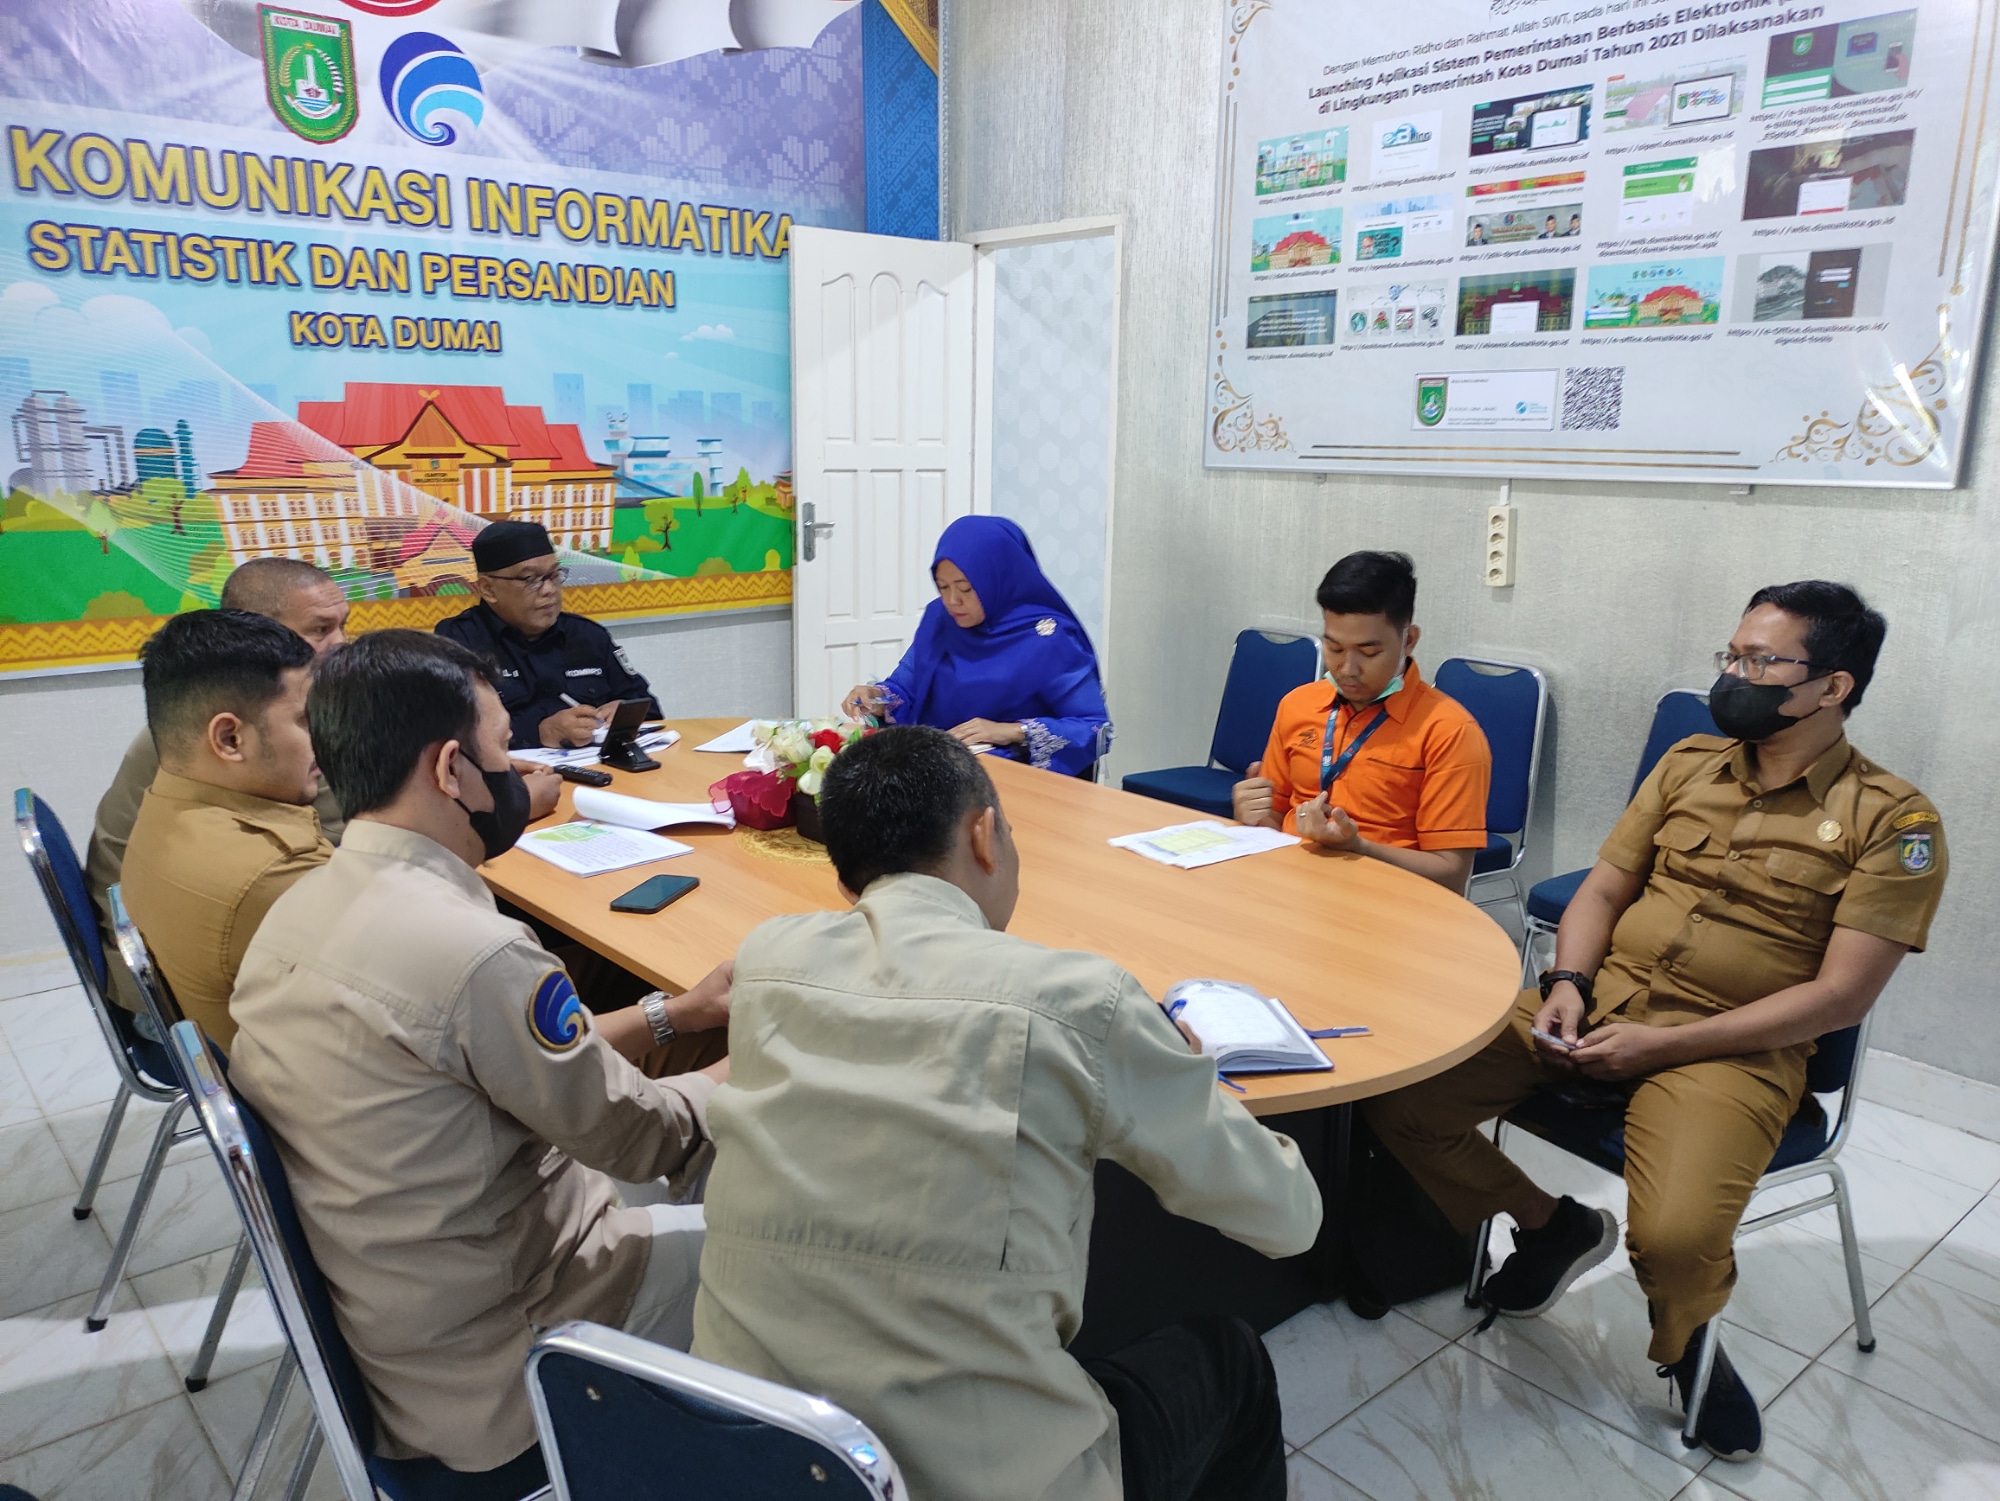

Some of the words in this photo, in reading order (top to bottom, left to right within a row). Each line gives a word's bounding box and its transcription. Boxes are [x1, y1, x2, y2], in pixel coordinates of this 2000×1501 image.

[1308, 76, 1374, 99] Launching
[1375, 61, 1430, 86] Aplikasi
[1431, 54, 1481, 74] Sistem
[1483, 31, 1593, 64] Pemerintahan
[1597, 12, 1671, 40] Berbasis
[1318, 98, 1331, 115] di
[1332, 86, 1410, 112] Lingkungan
[1412, 67, 1494, 97] Pemerintah
[1497, 61, 1533, 80] Kota
[1535, 48, 1590, 74] Dumai
[1592, 40, 1644, 62] Tahun
[1648, 29, 1688, 52] 2021
[1691, 5, 1825, 43] Dilaksanakan
[1323, 61, 1361, 75] Dengan
[1361, 49, 1412, 68] Memohon
[1412, 42, 1443, 57] Ridho
[1444, 36, 1466, 50] dan
[1466, 27, 1510, 45] Rahmat
[1511, 20, 1540, 35] Allah
[1541, 12, 1572, 29] SWT,
[1573, 3, 1604, 24] pada
[1605, 0, 1632, 15] hari
[8, 125, 453, 229] KOMUNIKASI
[469, 177, 791, 259] INFORMATIKA
[28, 220, 300, 287] STATISTIK
[311, 246, 408, 293] DAN
[421, 254, 677, 310] PERSANDIAN
[290, 312, 386, 350] KOTA
[394, 317, 502, 353] DUMAI
